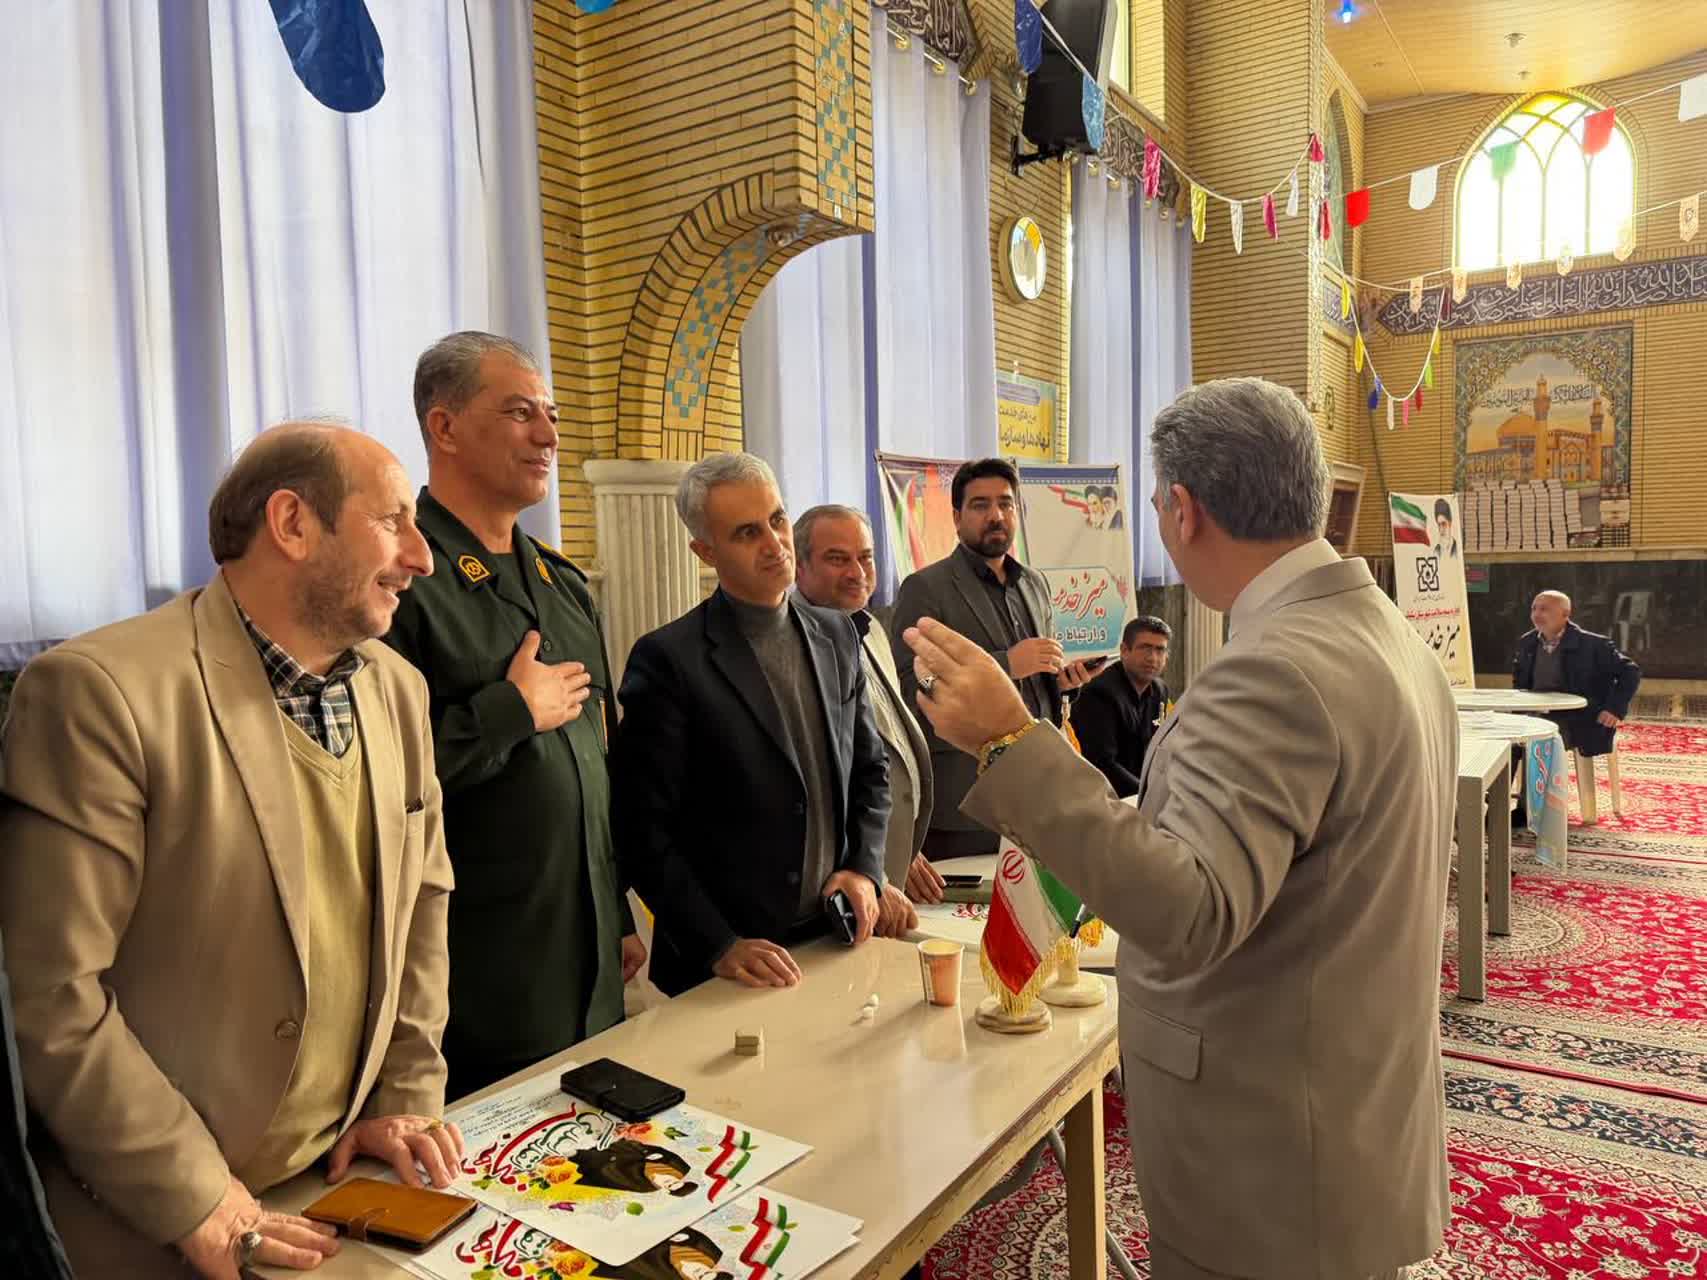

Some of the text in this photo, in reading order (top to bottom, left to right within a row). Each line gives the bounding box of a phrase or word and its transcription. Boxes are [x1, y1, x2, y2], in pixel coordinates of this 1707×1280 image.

[1052, 575, 1081, 614] خدم
[1066, 627, 1097, 643] ارتباط
[1425, 624, 1444, 651] خدم
